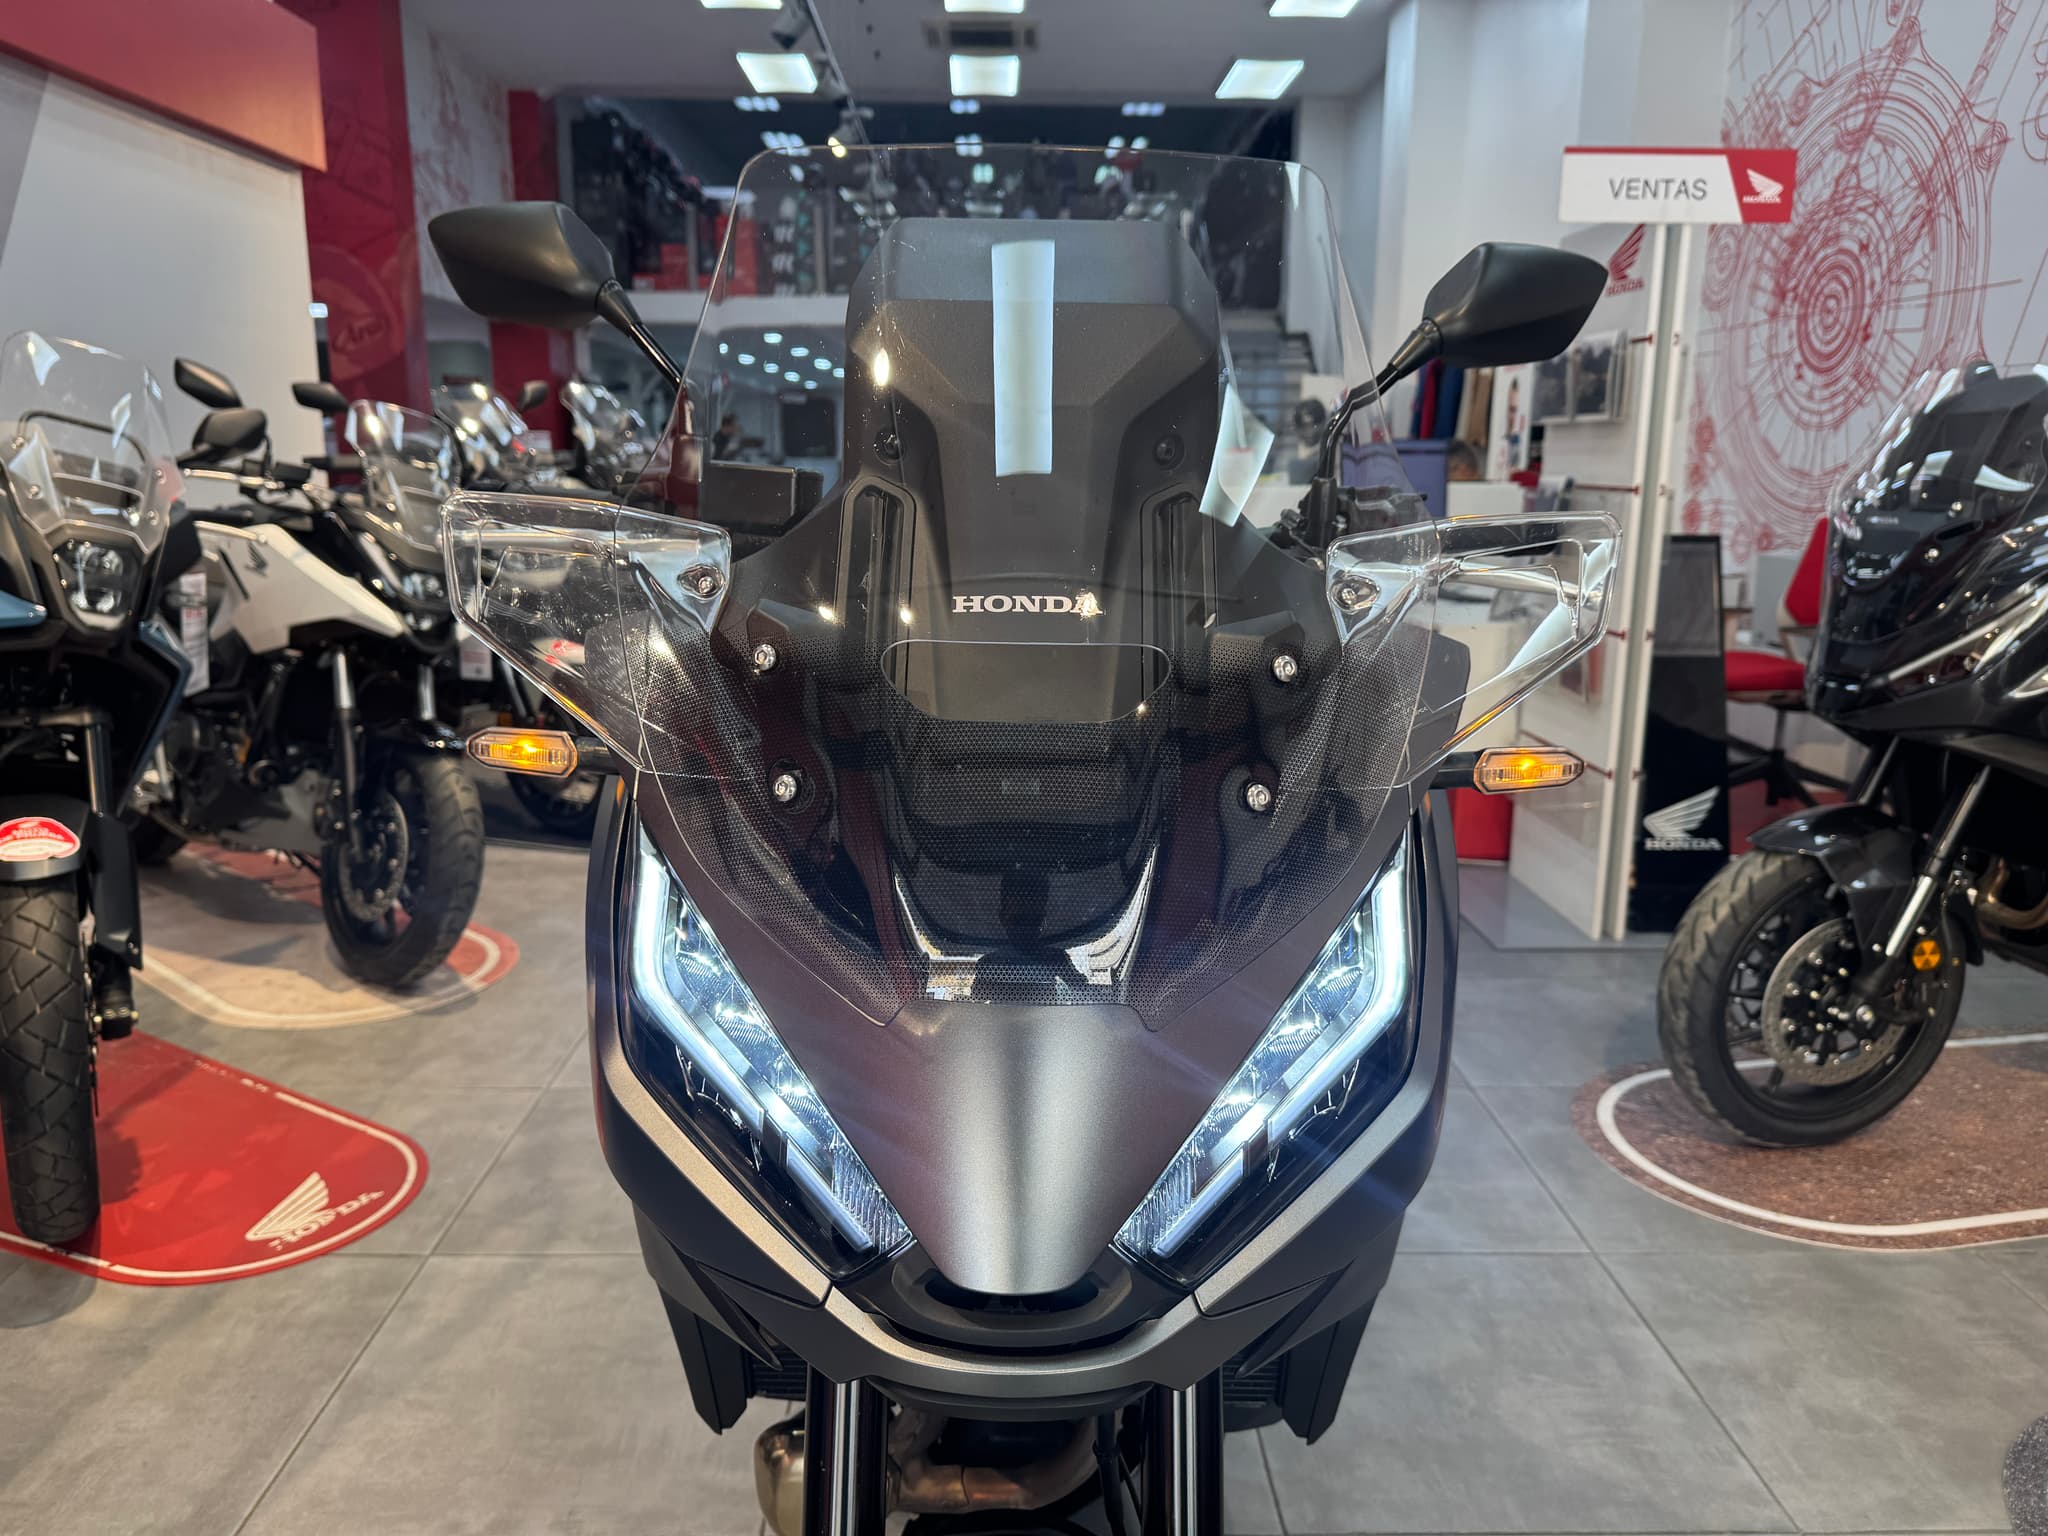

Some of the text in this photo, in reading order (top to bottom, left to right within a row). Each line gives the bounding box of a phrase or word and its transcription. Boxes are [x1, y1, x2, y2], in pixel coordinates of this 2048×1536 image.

[1609, 177, 1708, 200] VENTAS
[952, 595, 1103, 613] HONDA
[1644, 838, 1722, 851] HONDA
